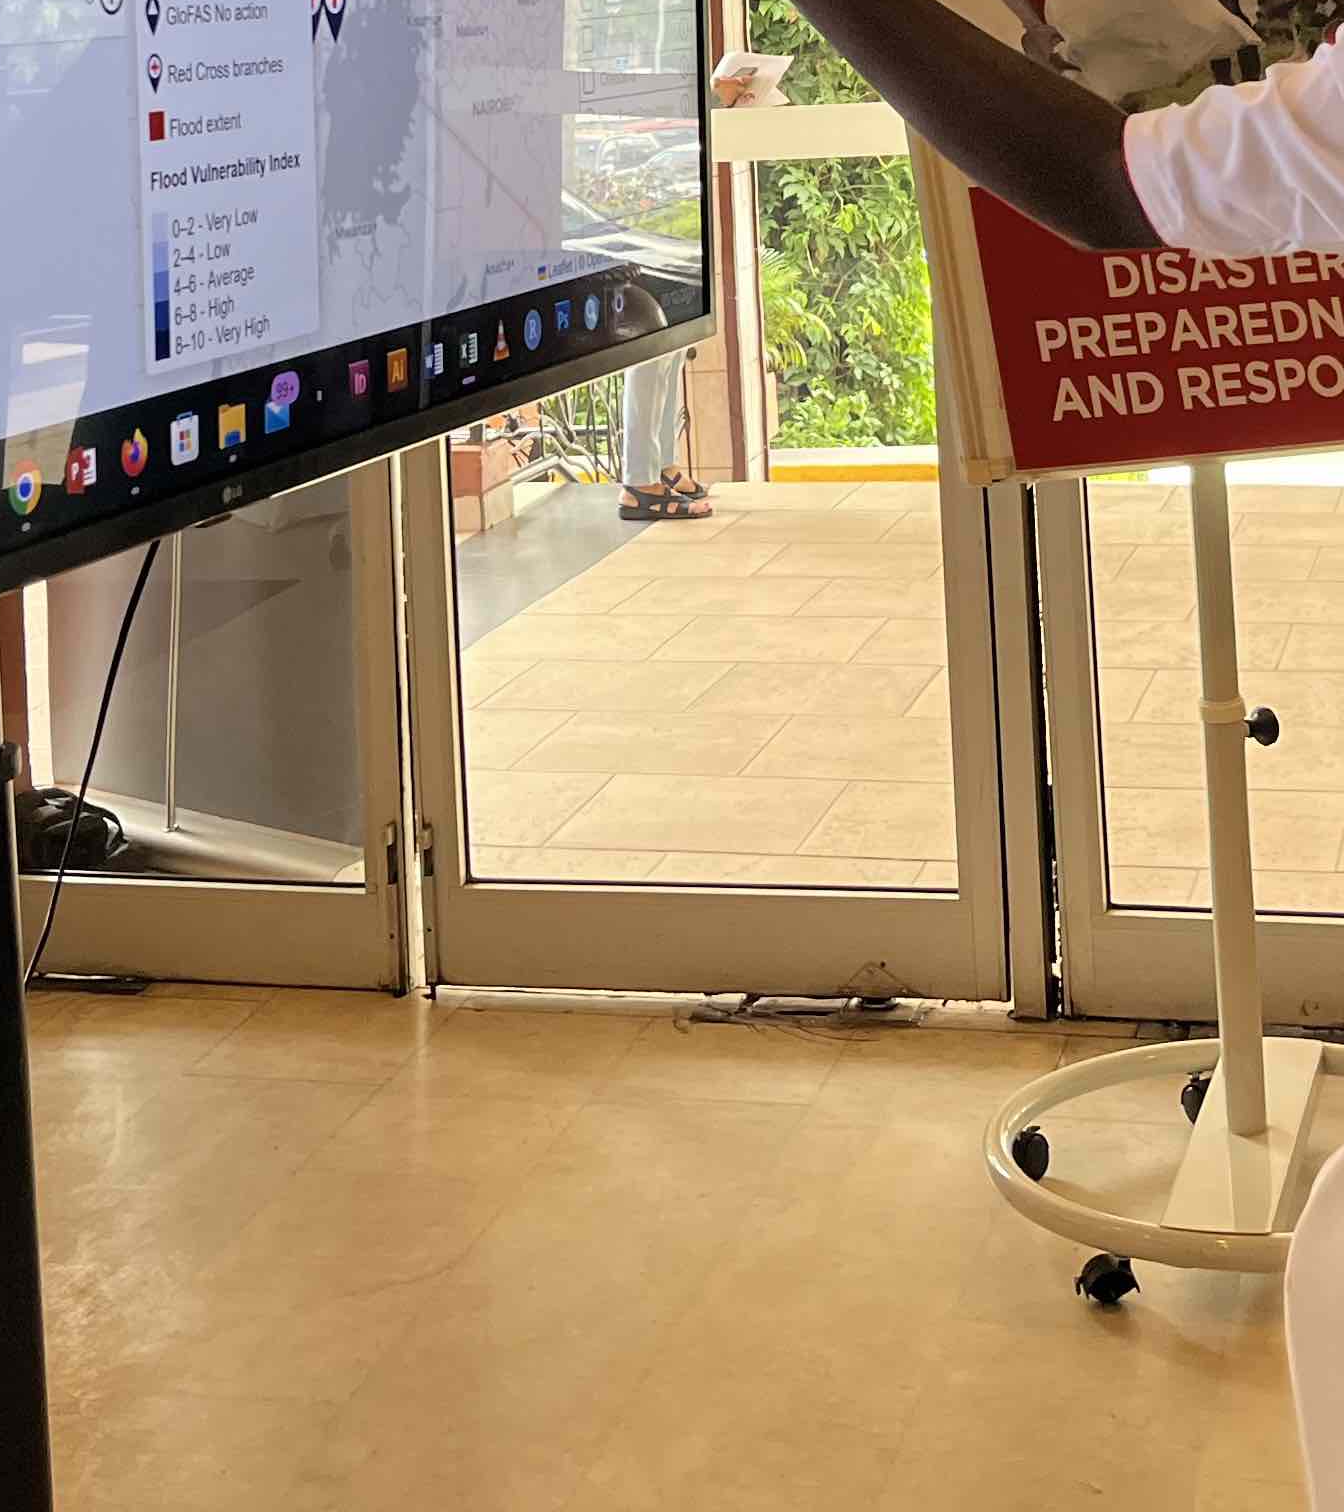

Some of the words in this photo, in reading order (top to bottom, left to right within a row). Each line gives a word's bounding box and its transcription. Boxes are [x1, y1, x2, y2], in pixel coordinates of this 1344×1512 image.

[168, 66, 193, 85] Red
[197, 62, 230, 82] Cross
[229, 56, 284, 76] branches
[169, 117, 204, 137] Flood
[207, 114, 241, 132] extent
[151, 168, 187, 191] Flood
[190, 156, 266, 186] Vulnerability
[269, 153, 301, 174] Index
[1052, 371, 1163, 422] AND
